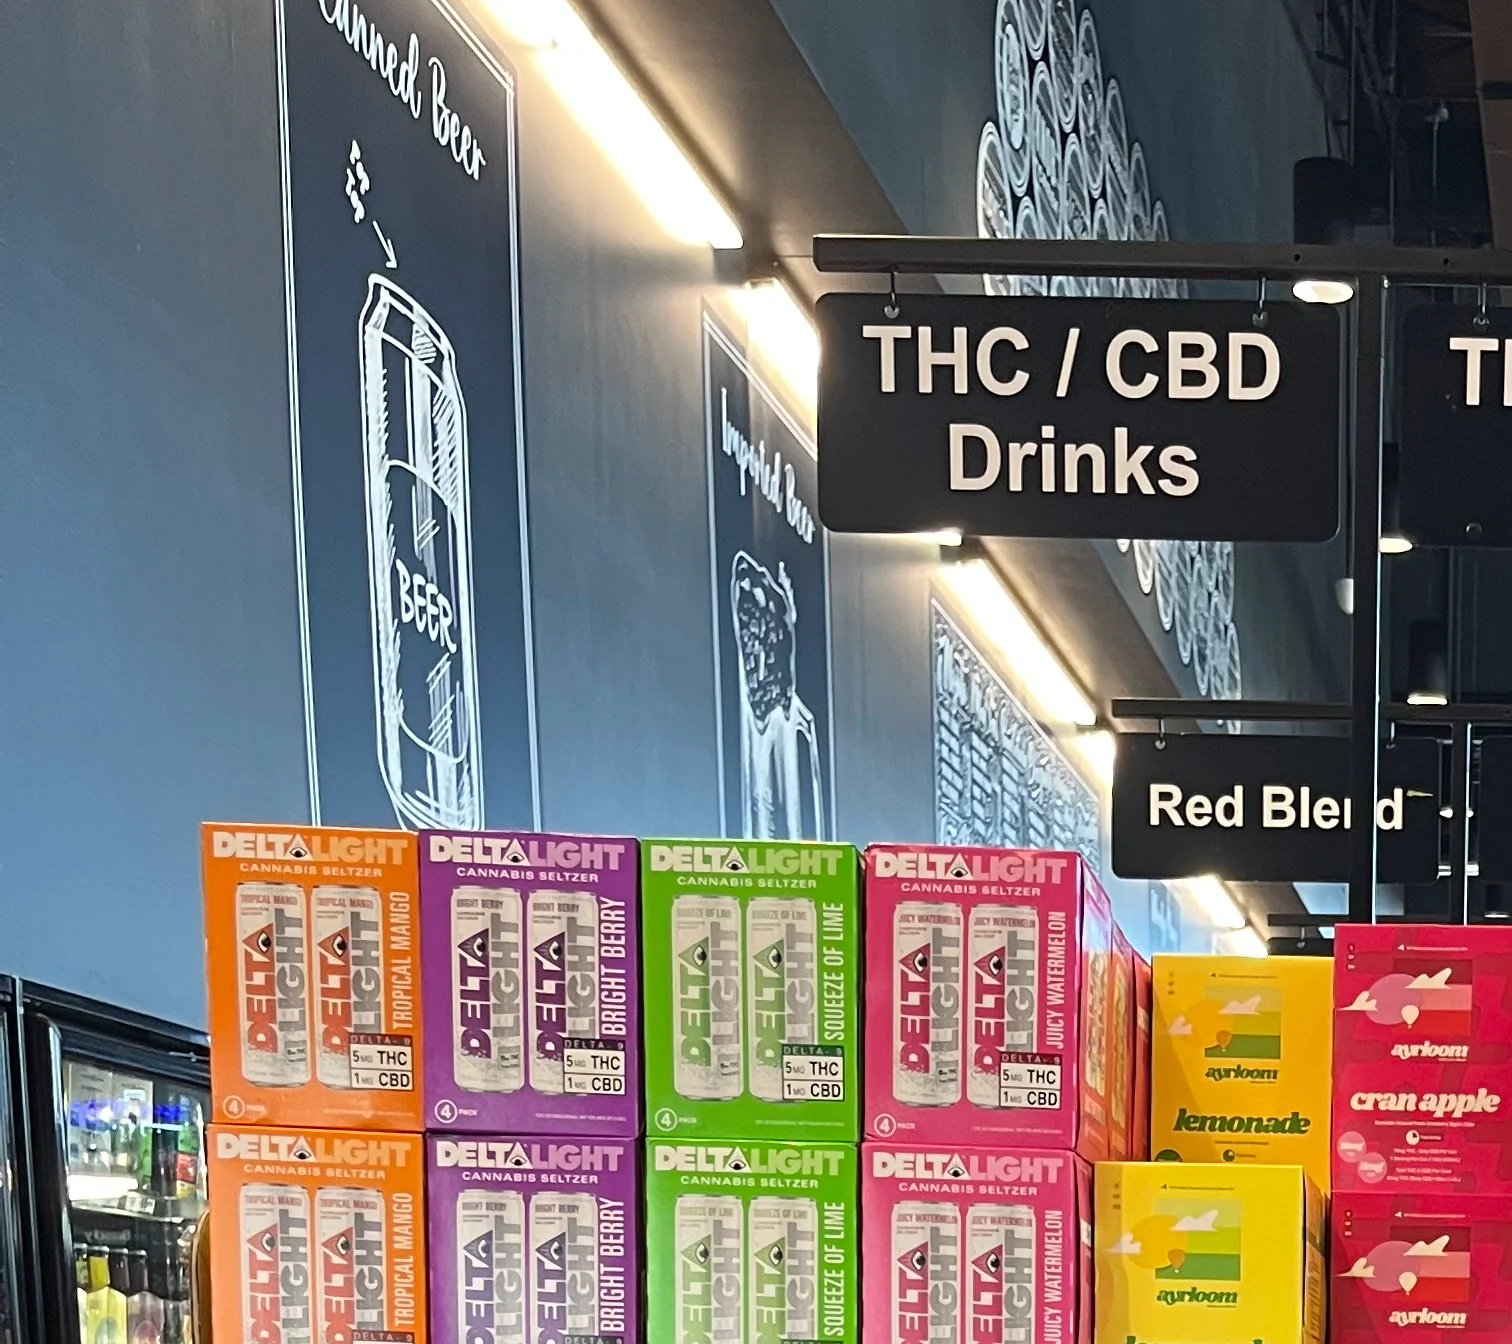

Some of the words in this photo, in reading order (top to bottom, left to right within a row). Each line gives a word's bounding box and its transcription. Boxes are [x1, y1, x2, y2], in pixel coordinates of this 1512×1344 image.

[428, 57, 486, 180] Beer
[862, 324, 1030, 397] THC
[1056, 328, 1080, 398] /
[1105, 330, 1281, 401] CBD
[949, 423, 1200, 497] Drinks
[395, 558, 458, 655] BEER
[1150, 784, 1244, 828] Red
[240, 863, 318, 875] CANNABIS
[322, 867, 382, 878] SELTZER
[456, 867, 534, 880] CANNABIS
[539, 871, 599, 883] SELTZER
[394, 891, 411, 955] MANGO
[602, 896, 626, 959] BERRY
[824, 902, 844, 941] LIME
[824, 947, 844, 965] OF
[1047, 911, 1066, 1001] WATERMELON
[392, 959, 414, 1030] TROPICAL
[602, 963, 626, 1036] BRIGHT
[824, 972, 844, 1041] SQUEEZE
[1046, 1006, 1064, 1050] JUICY
[377, 1050, 408, 1068] THC
[378, 1073, 411, 1090] CBD
[1156, 1287, 1237, 1305] ayrloom
[1389, 1307, 1466, 1326] ayrloom
